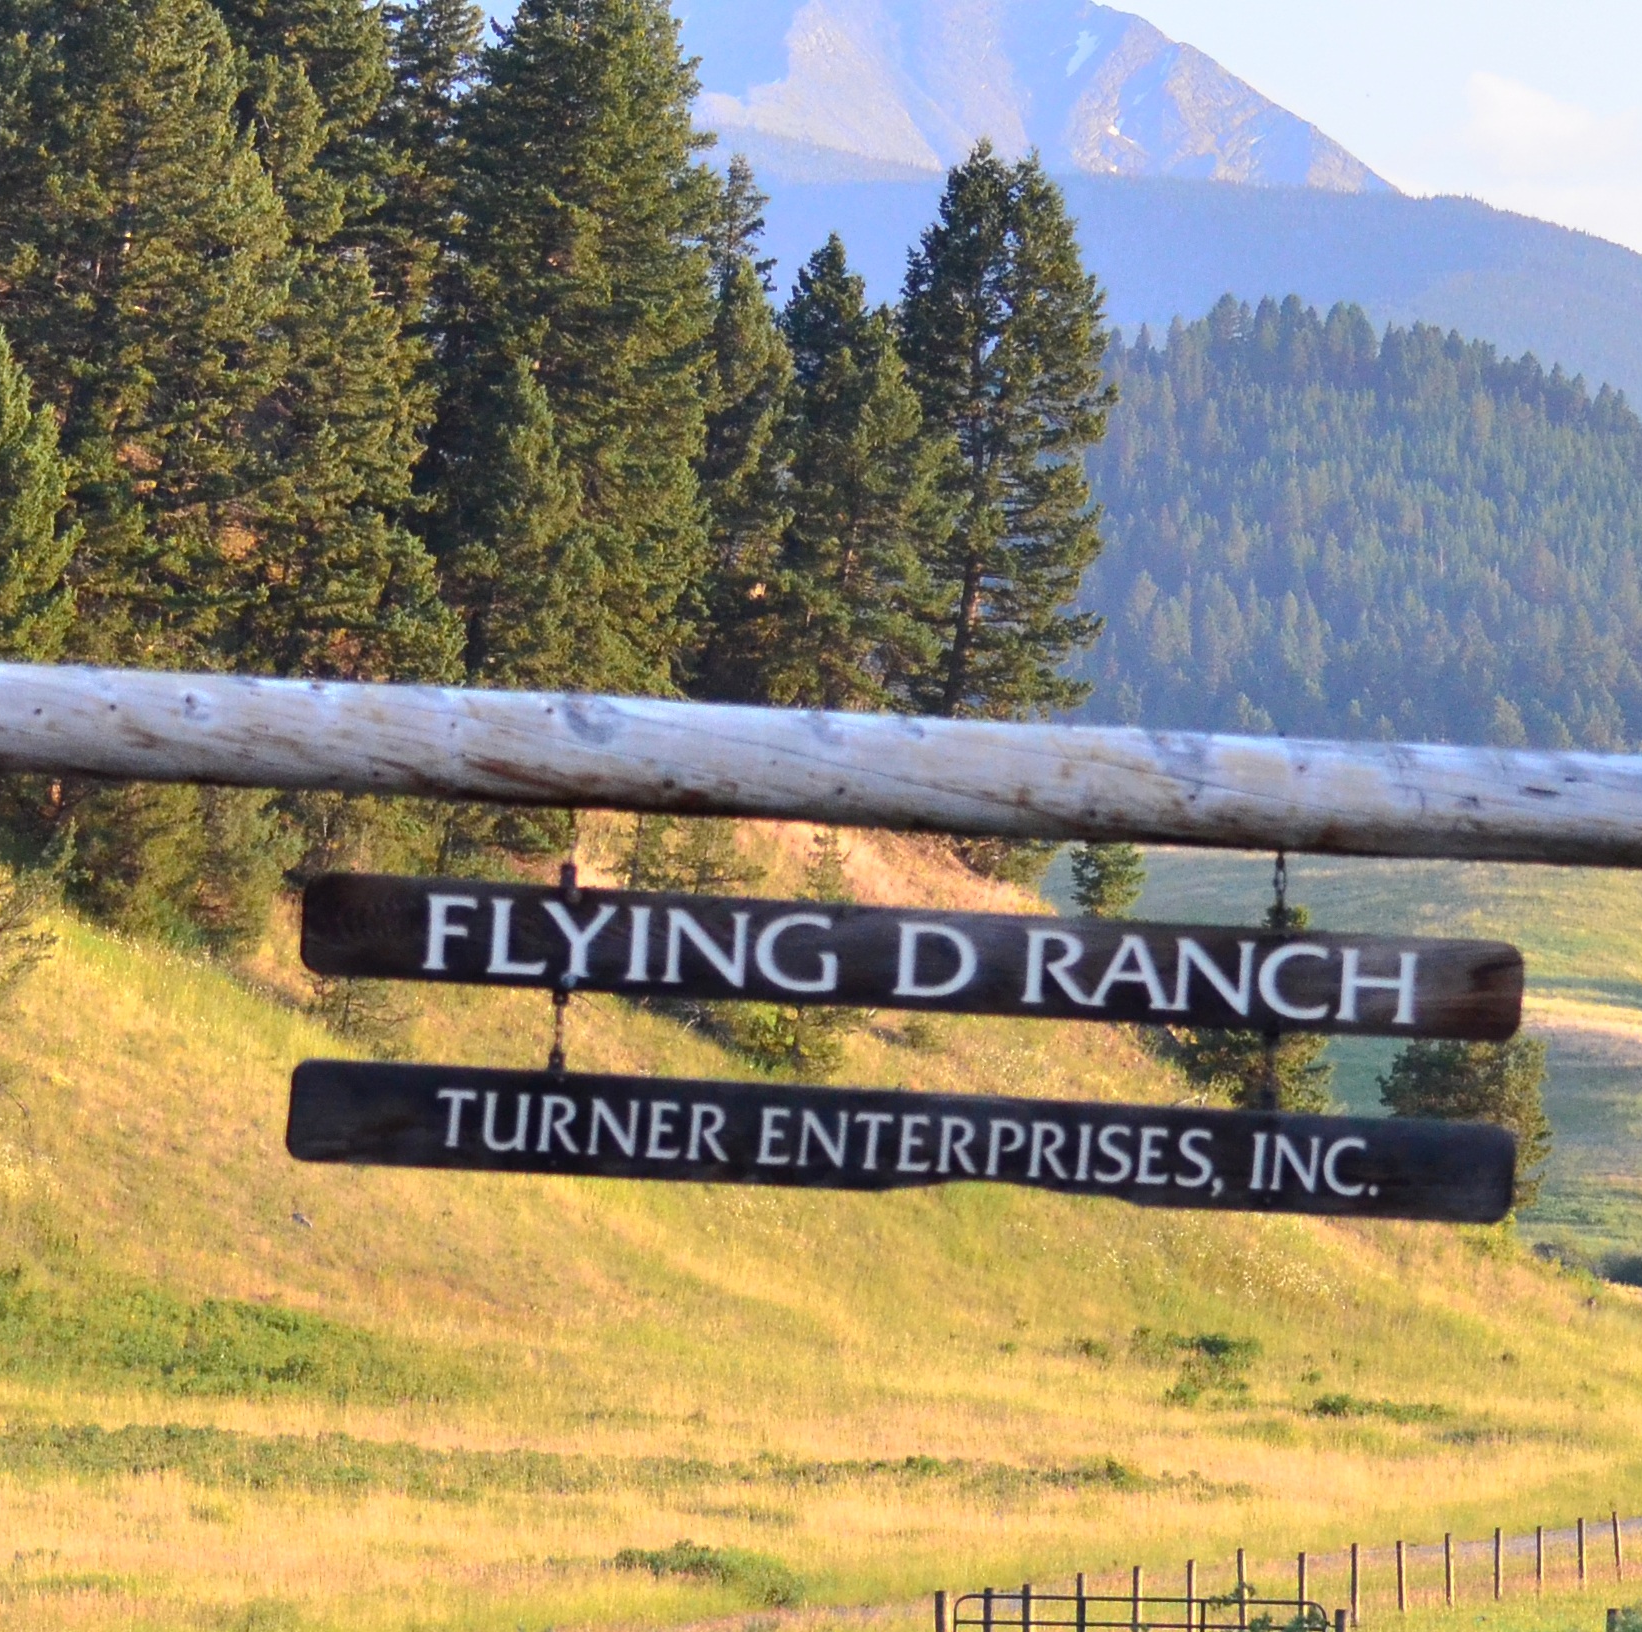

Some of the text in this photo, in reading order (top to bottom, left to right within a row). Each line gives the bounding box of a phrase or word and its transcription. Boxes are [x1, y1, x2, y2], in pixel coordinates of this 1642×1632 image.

[422, 894, 1419, 1025] FLYING D RANCH
[437, 1089, 1380, 1197] TURNER ENTERPRISES, INC.
